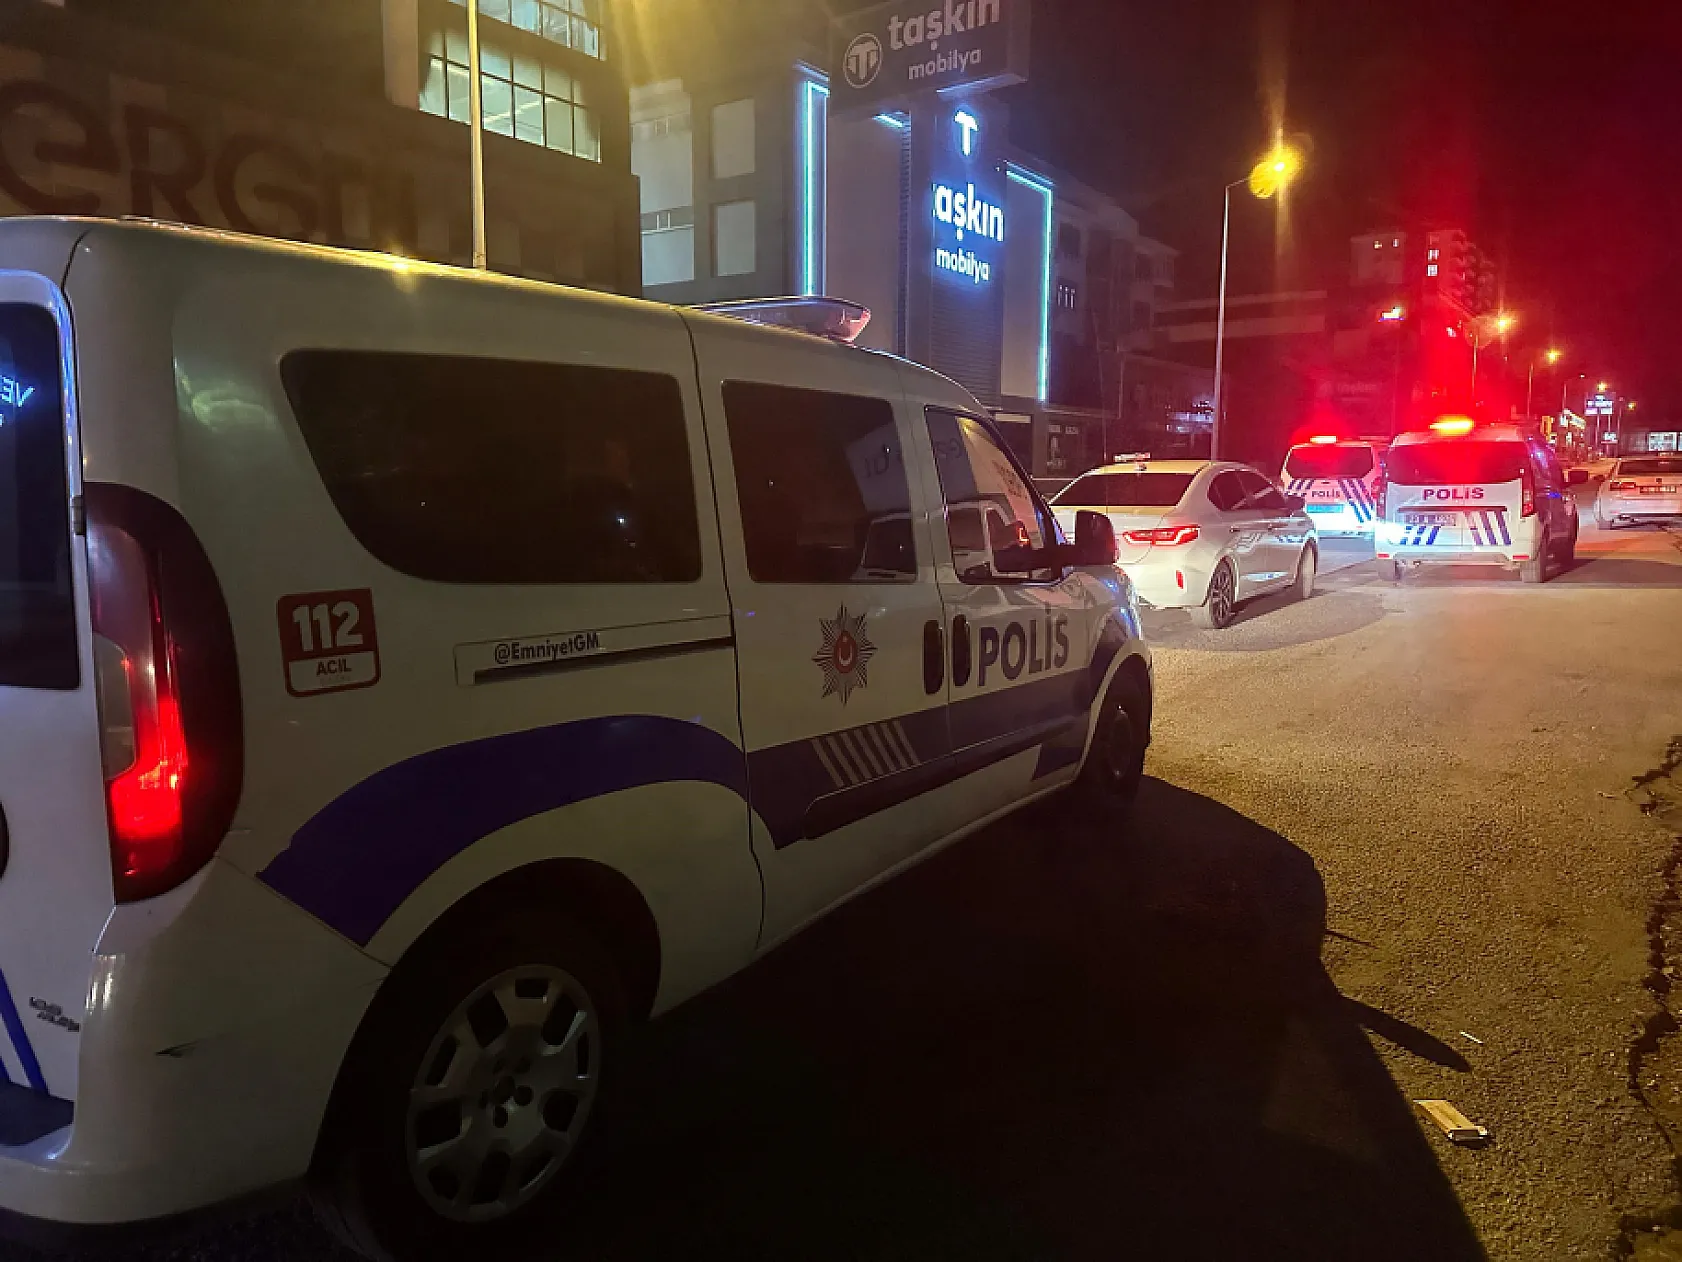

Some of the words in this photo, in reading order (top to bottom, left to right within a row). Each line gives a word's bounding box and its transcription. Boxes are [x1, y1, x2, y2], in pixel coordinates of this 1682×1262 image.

[908, 49, 982, 80] mobilya
[932, 183, 1004, 241] aşkın
[936, 248, 990, 284] mobilya
[292, 601, 363, 652] 112
[495, 632, 599, 665] @EmniyetGM
